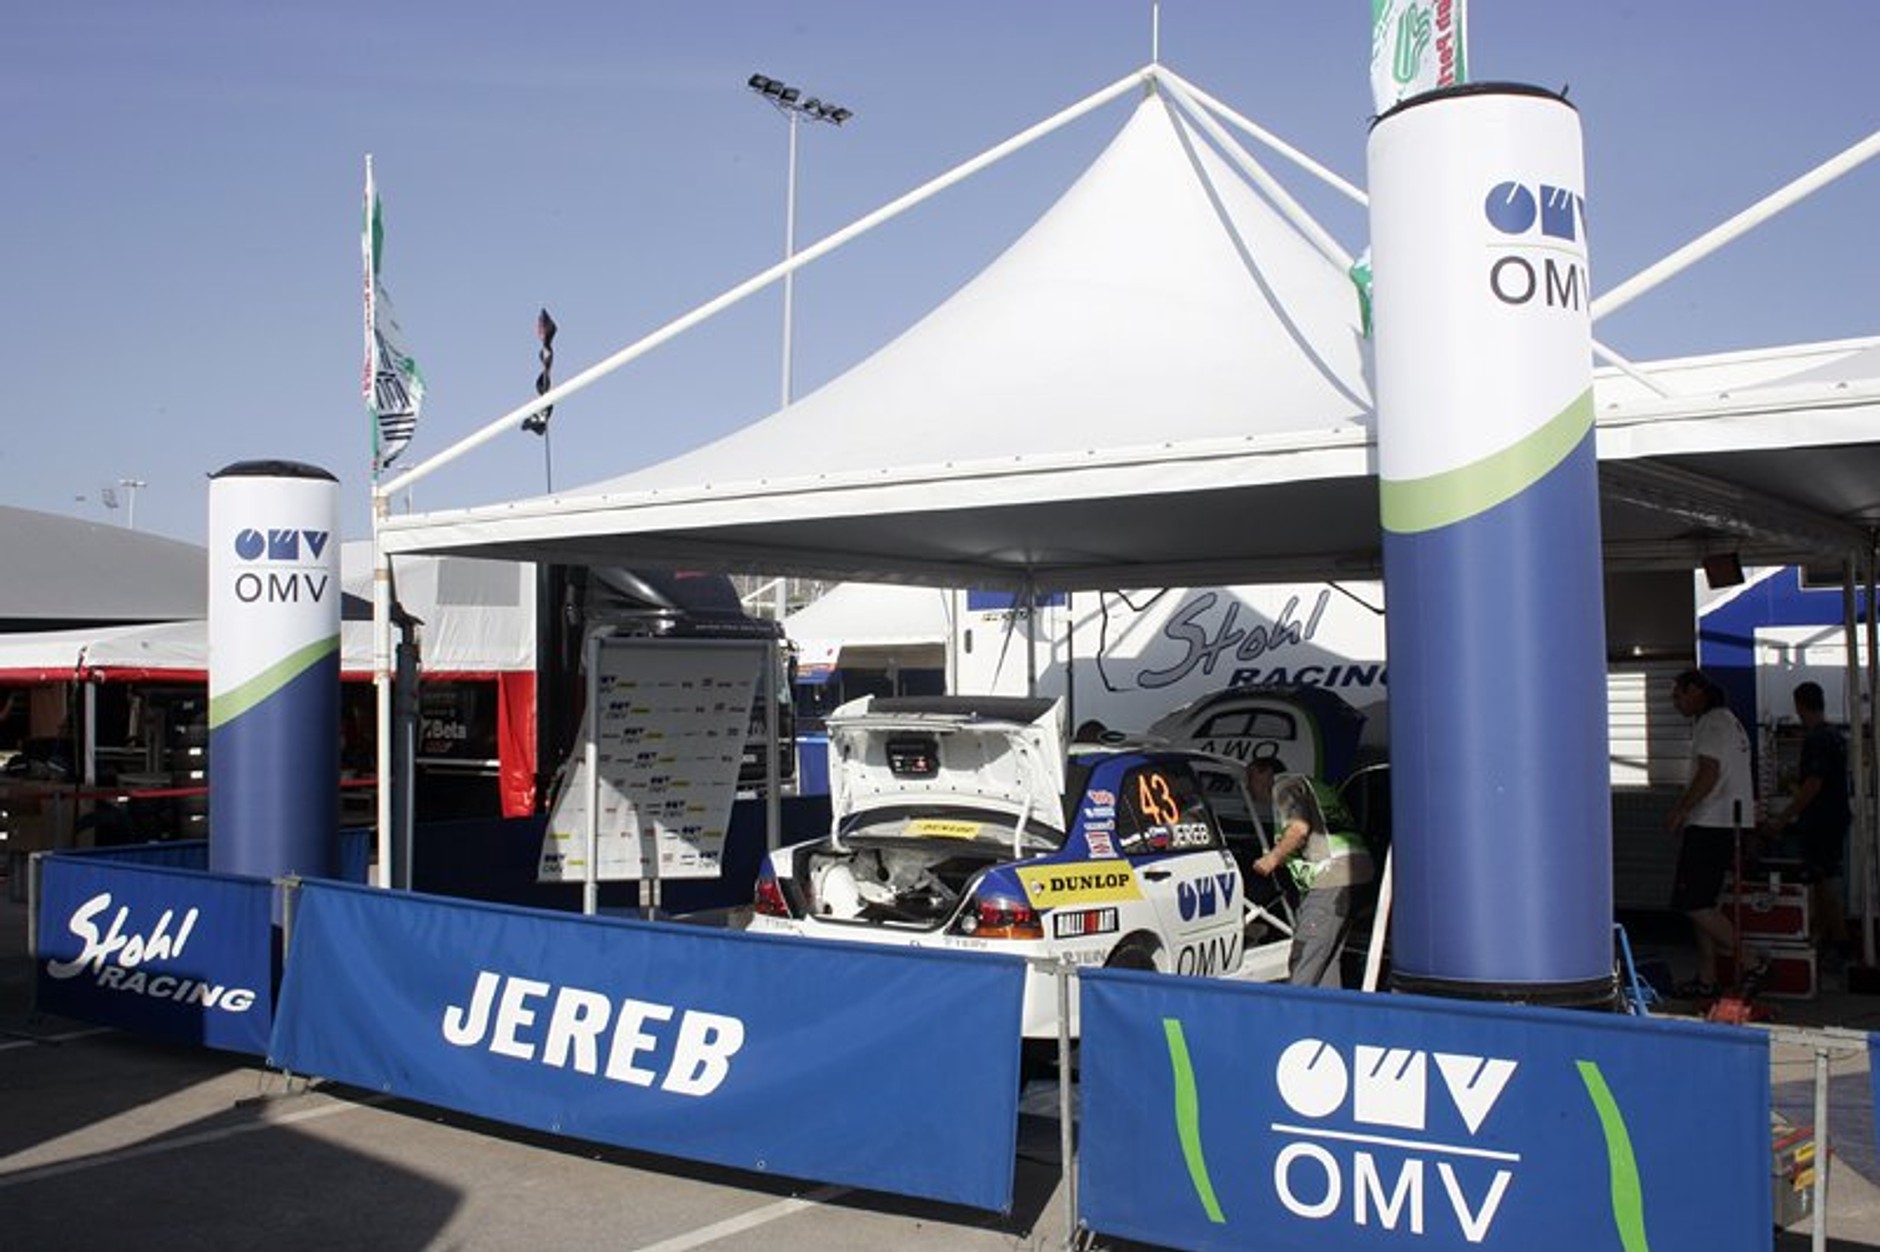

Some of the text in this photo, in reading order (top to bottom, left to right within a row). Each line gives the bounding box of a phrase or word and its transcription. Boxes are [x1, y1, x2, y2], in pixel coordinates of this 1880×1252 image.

[235, 573, 328, 603] OMV
[1137, 589, 1330, 689] Stohl
[1139, 774, 1179, 825] 43
[1172, 824, 1210, 847] JEREB
[1051, 874, 1130, 892] DUNLOP
[47, 892, 199, 979] Stohl
[1177, 933, 1238, 976] OMV
[97, 965, 257, 1012] RACING
[441, 970, 746, 1097] JEREB
[1274, 1141, 1513, 1244] OMV
